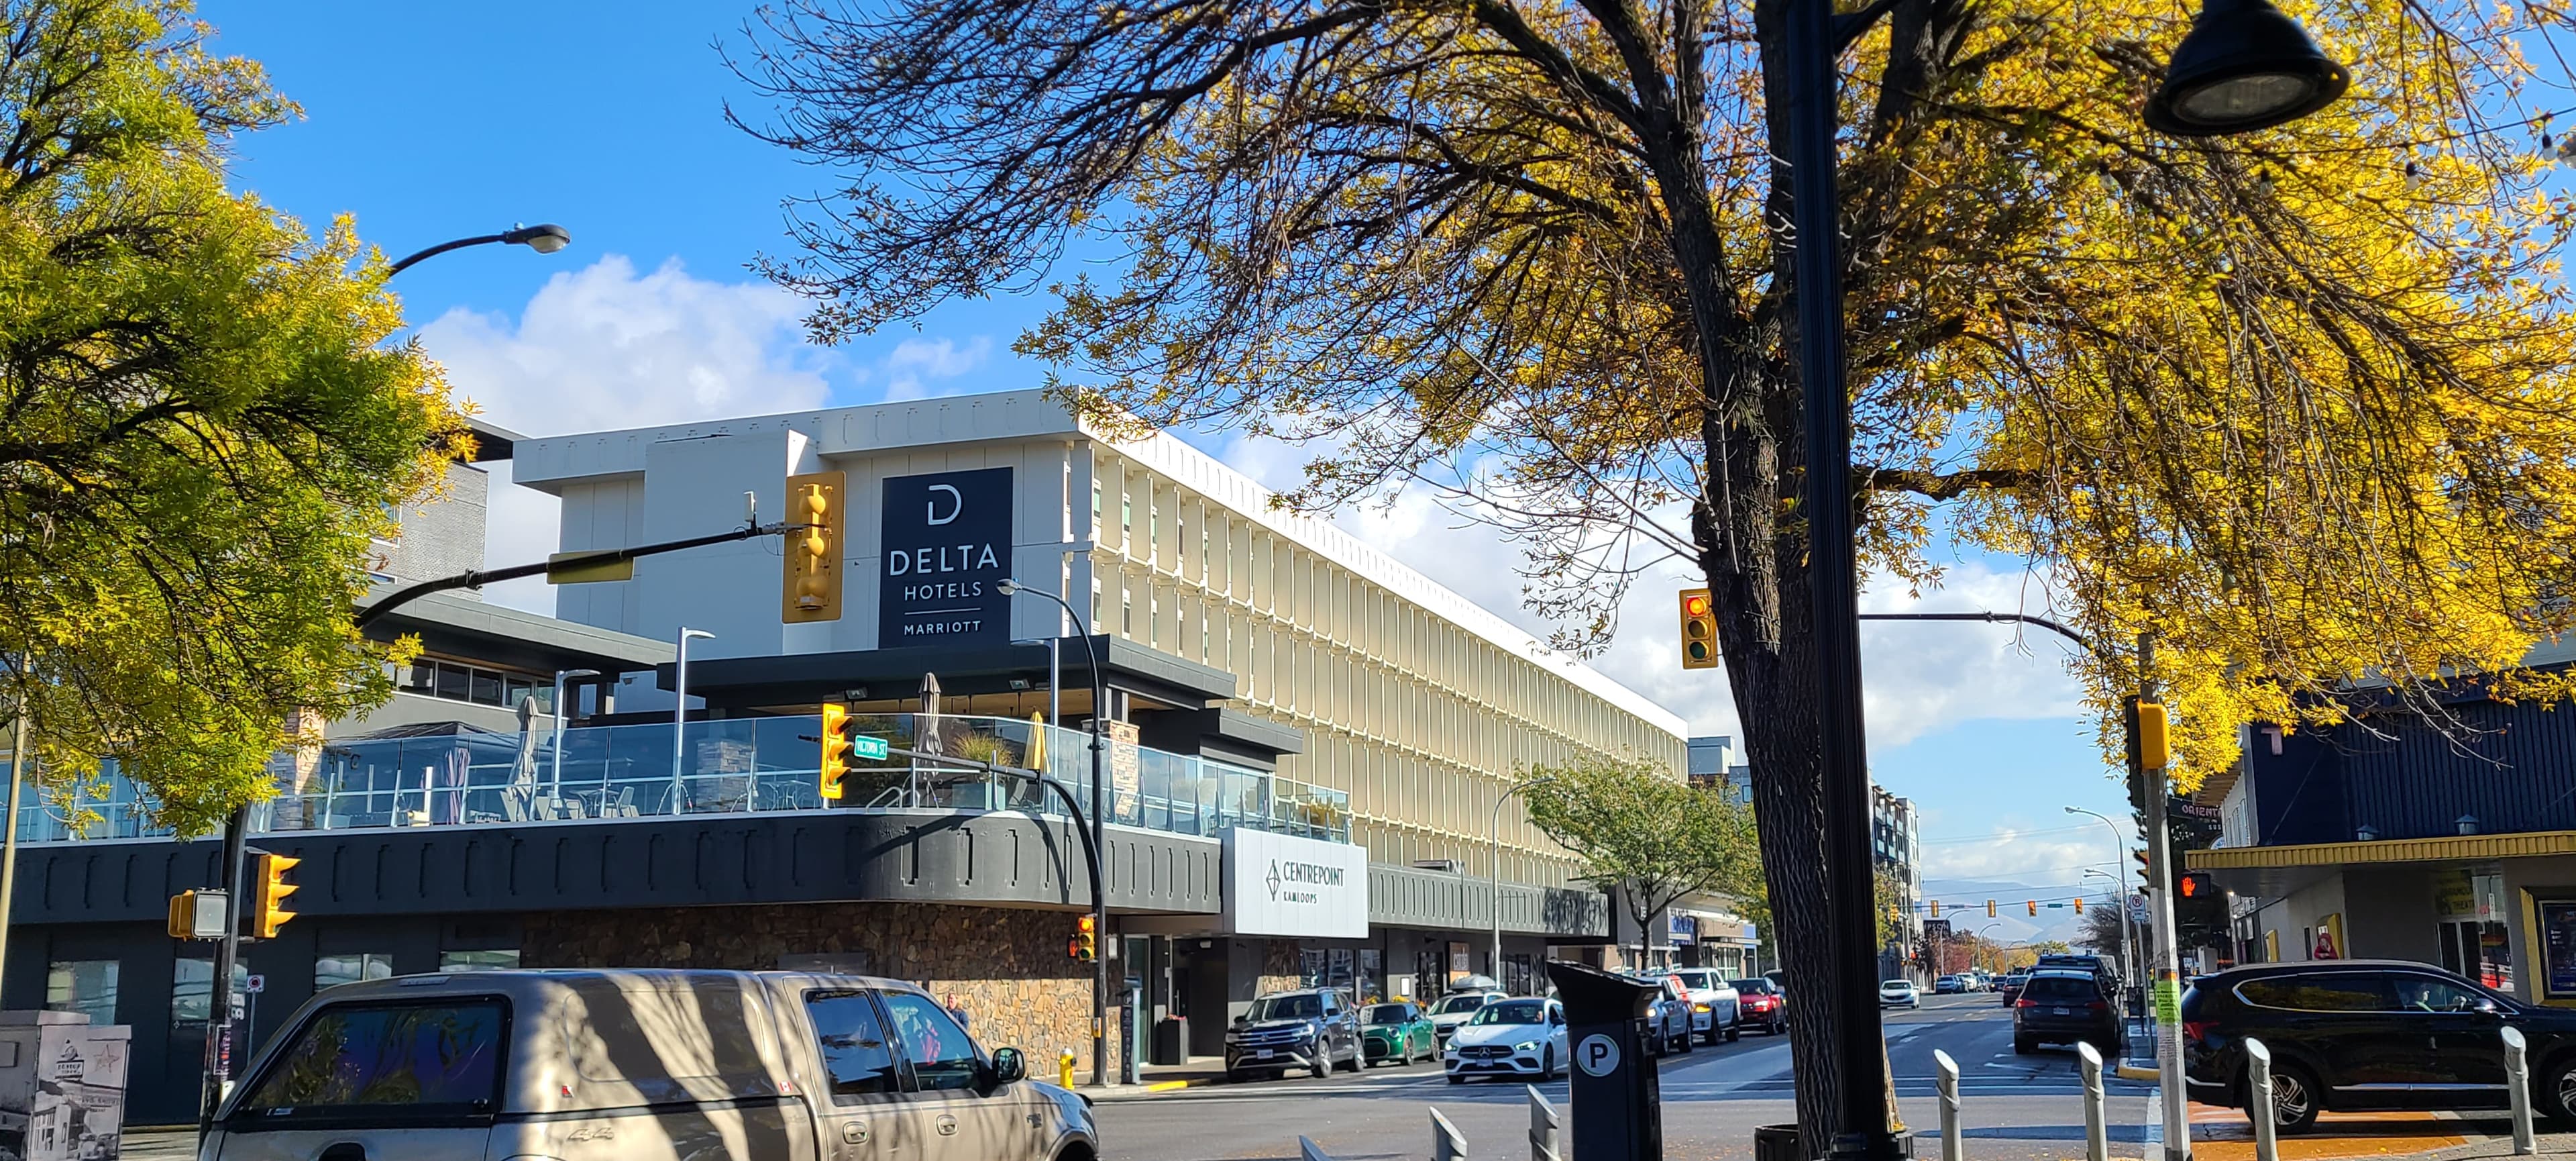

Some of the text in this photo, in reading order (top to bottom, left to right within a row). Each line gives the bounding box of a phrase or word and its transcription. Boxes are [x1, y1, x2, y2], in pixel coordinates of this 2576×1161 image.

[889, 542, 1000, 576] DELTA
[904, 580, 982, 601] HOTELS
[904, 619, 981, 636] MARRIOTT
[857, 740, 878, 754] VICTORIA
[1283, 861, 1345, 887] CENTREPOINT
[1283, 891, 1318, 904] KAMLOOPS
[1589, 1042, 1609, 1068] P
